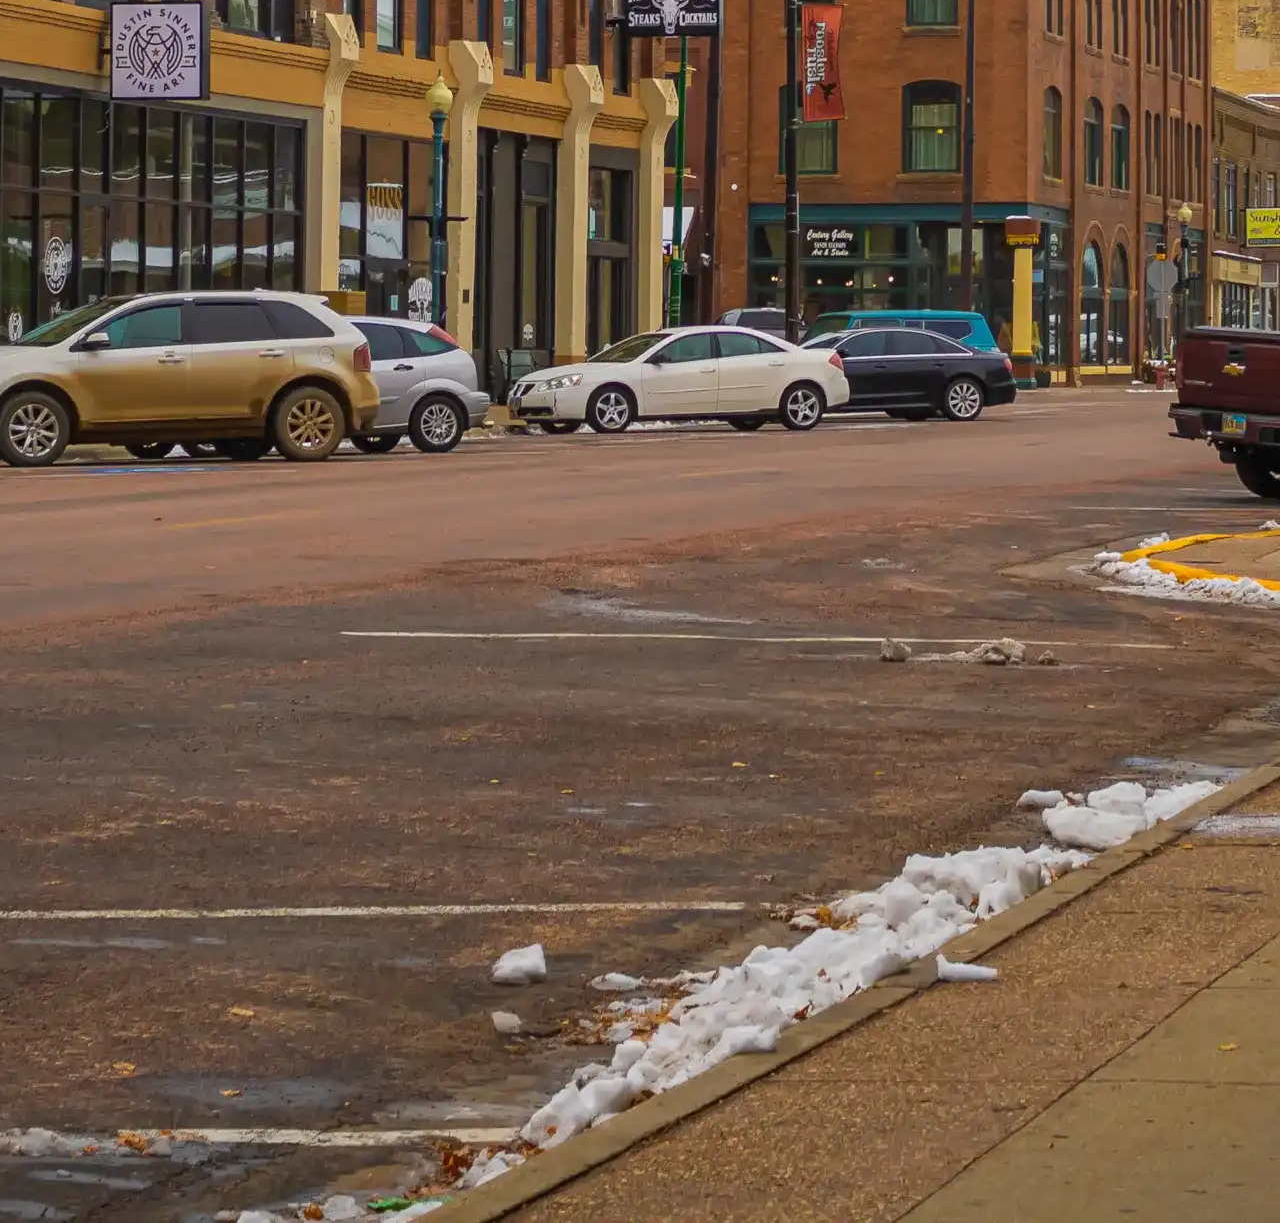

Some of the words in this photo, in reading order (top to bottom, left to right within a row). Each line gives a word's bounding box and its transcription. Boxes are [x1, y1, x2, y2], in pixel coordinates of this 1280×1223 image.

[116, 8, 152, 52] DUSTIN
[159, 8, 196, 51] SINNER
[125, 72, 155, 93] FINE
[163, 72, 186, 92] ART
